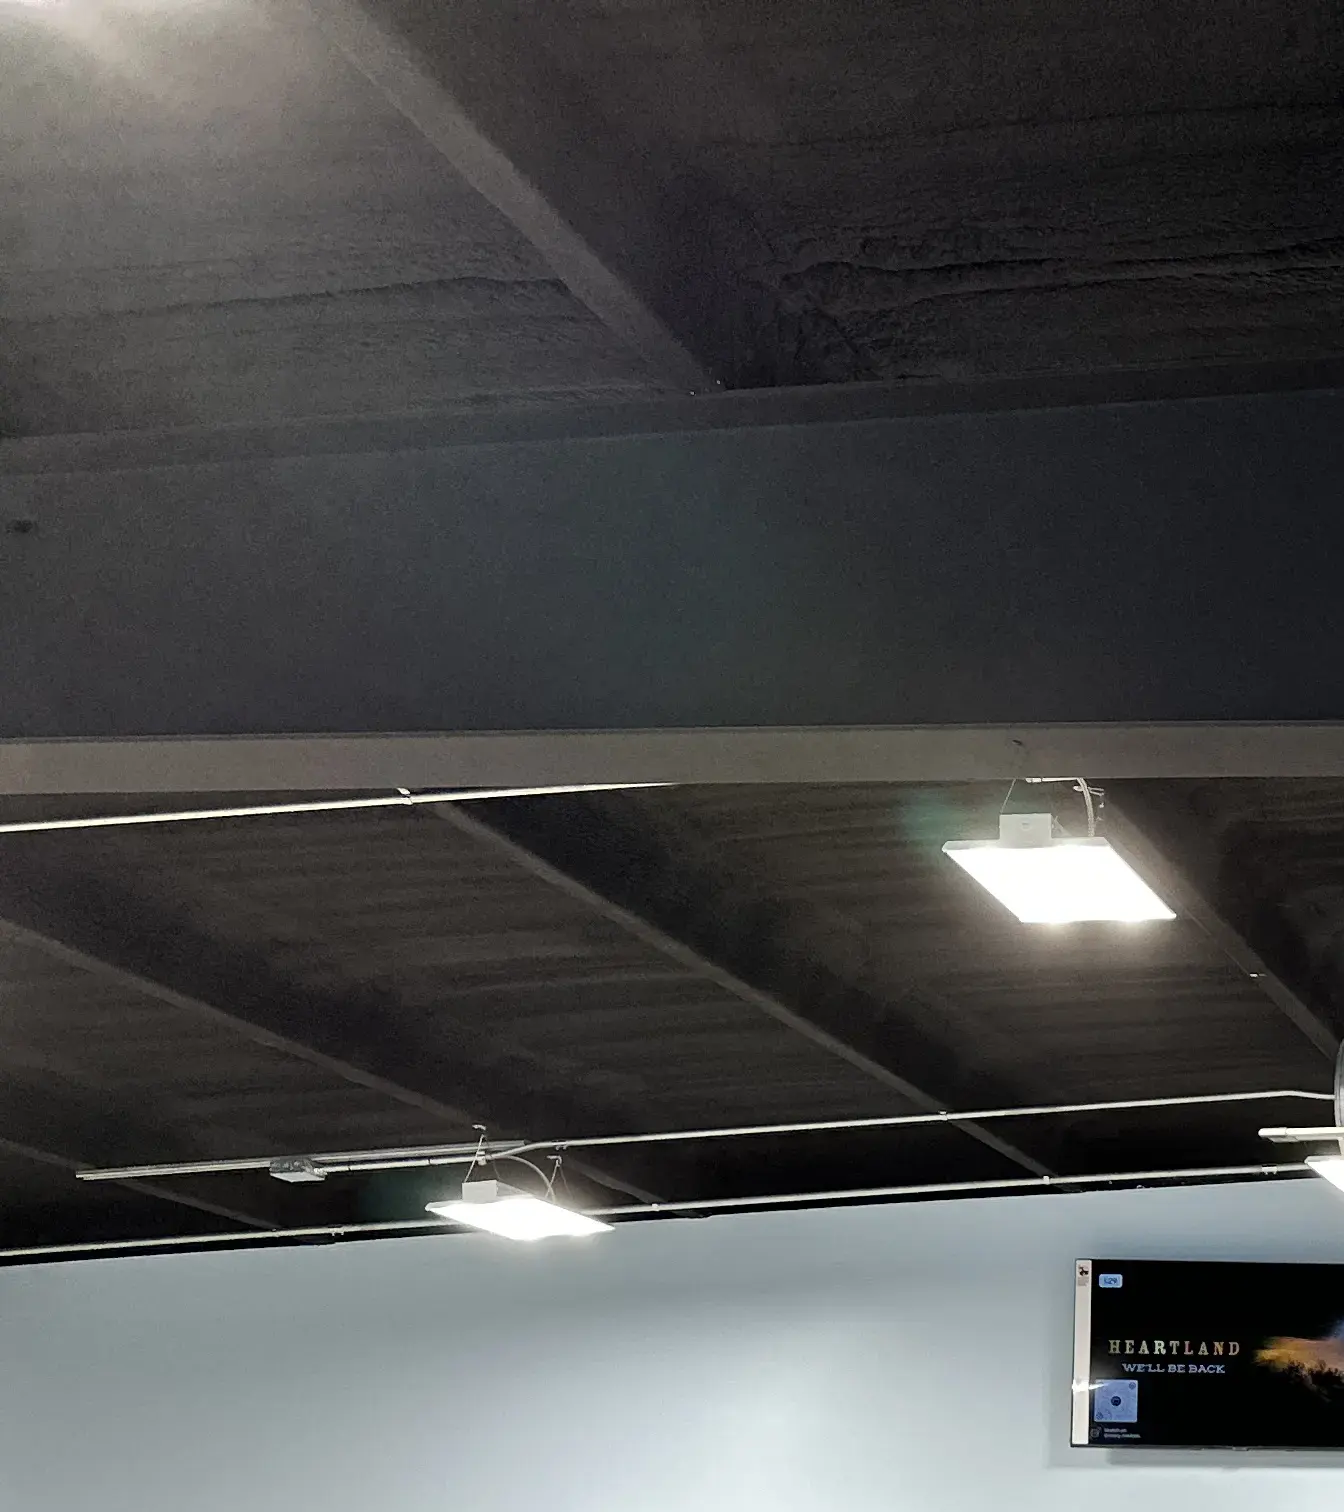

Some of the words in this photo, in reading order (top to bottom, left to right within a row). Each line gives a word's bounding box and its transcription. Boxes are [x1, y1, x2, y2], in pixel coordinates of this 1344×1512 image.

[1108, 1340, 1240, 1356] HEARTLAND
[1168, 1363, 1185, 1374] BE
[1188, 1364, 1225, 1374] BACK
